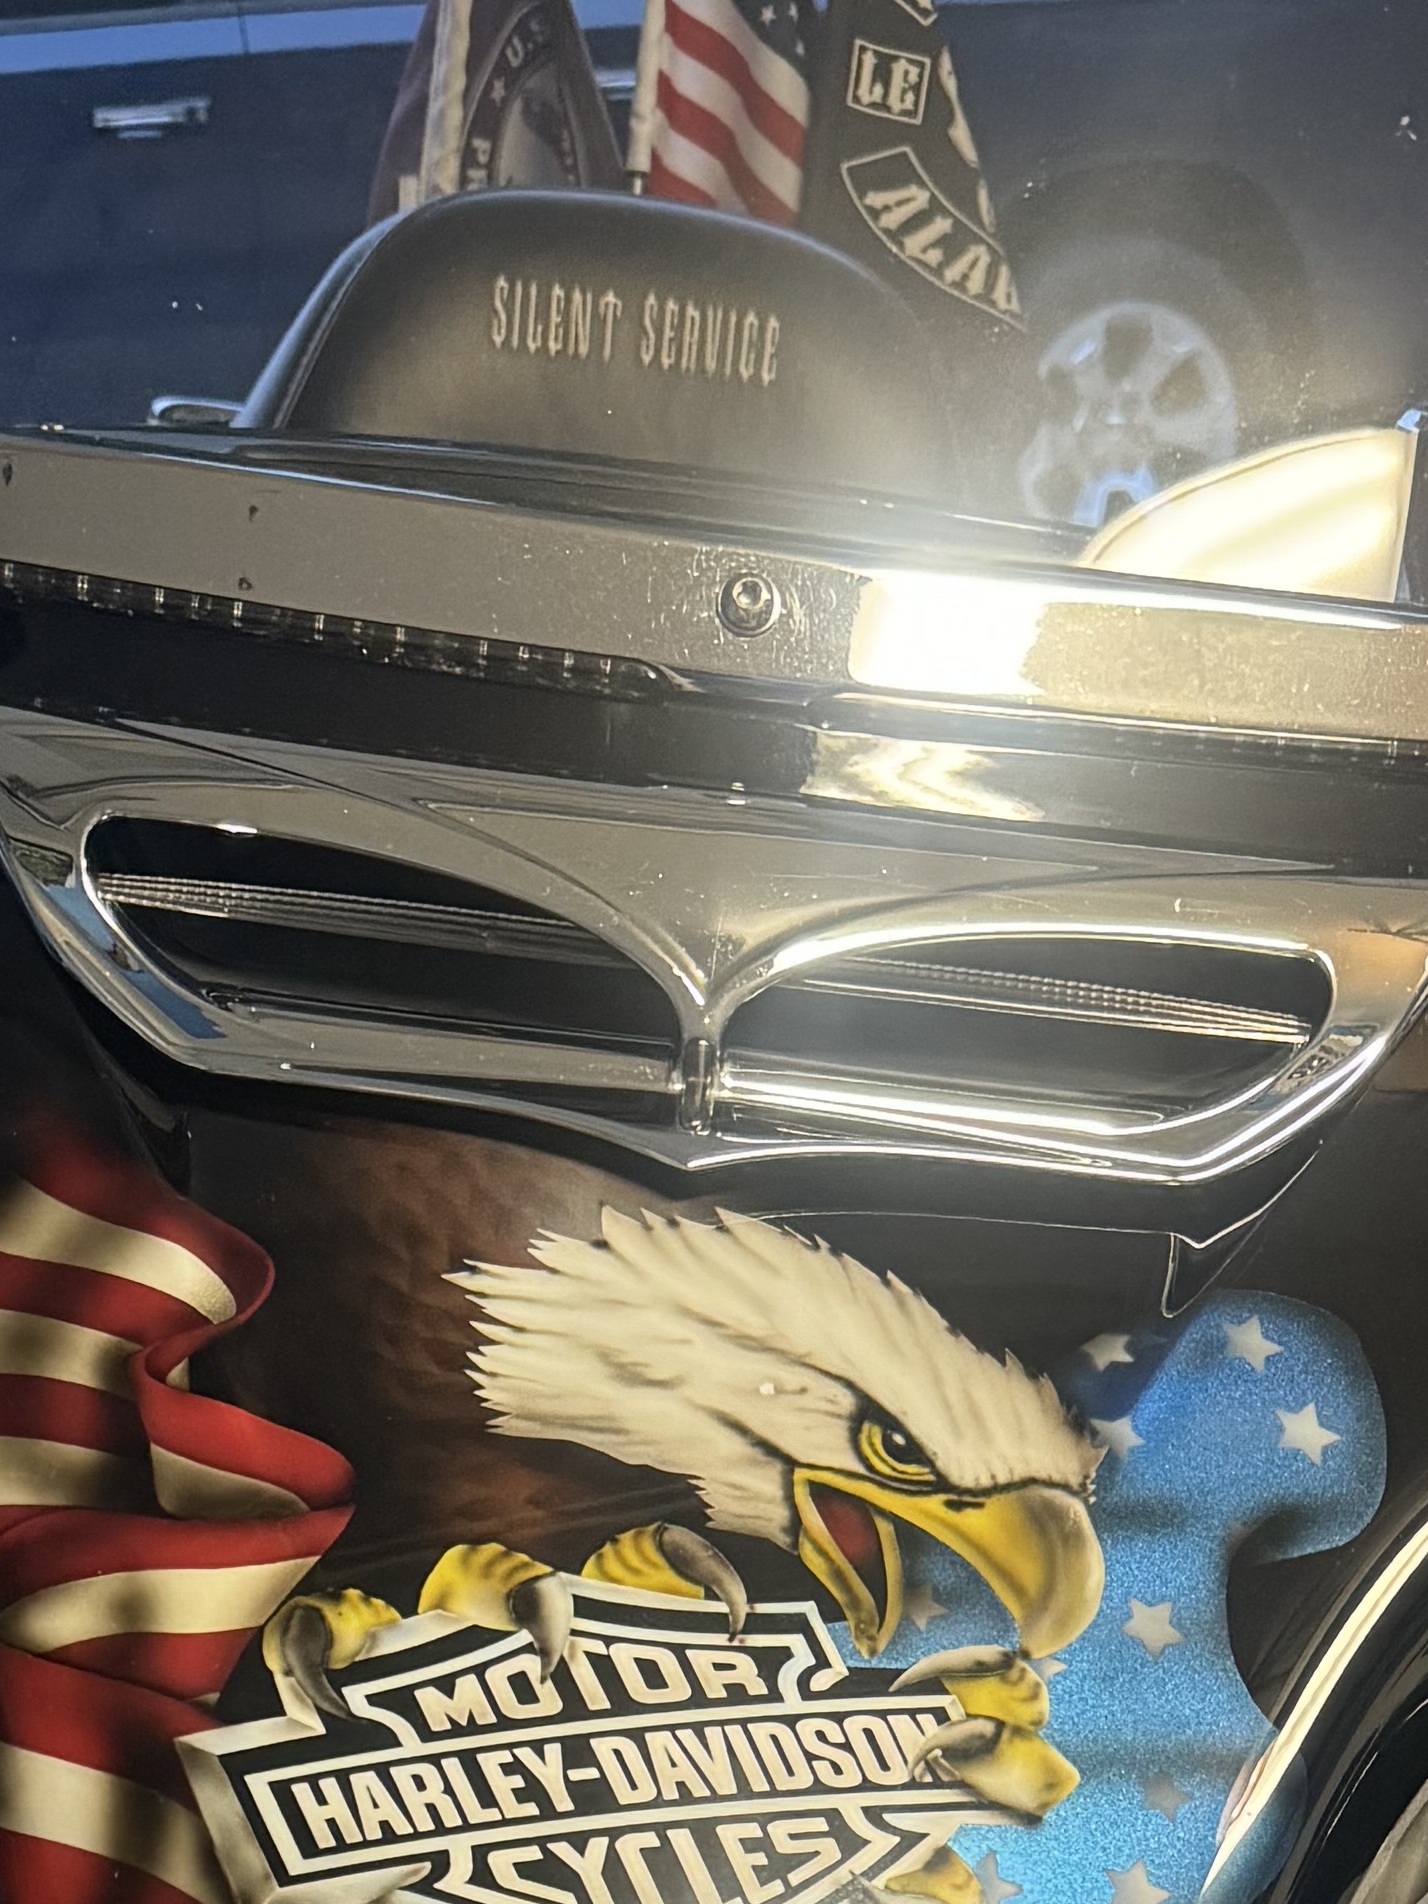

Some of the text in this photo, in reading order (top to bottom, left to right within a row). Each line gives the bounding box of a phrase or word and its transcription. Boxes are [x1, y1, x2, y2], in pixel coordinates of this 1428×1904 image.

[855, 49, 922, 114] LE
[491, 274, 780, 388] SILENT SERVICE
[412, 1638, 769, 1733] MOTOR
[290, 1712, 960, 1851] HARLEY-DAVIDSON
